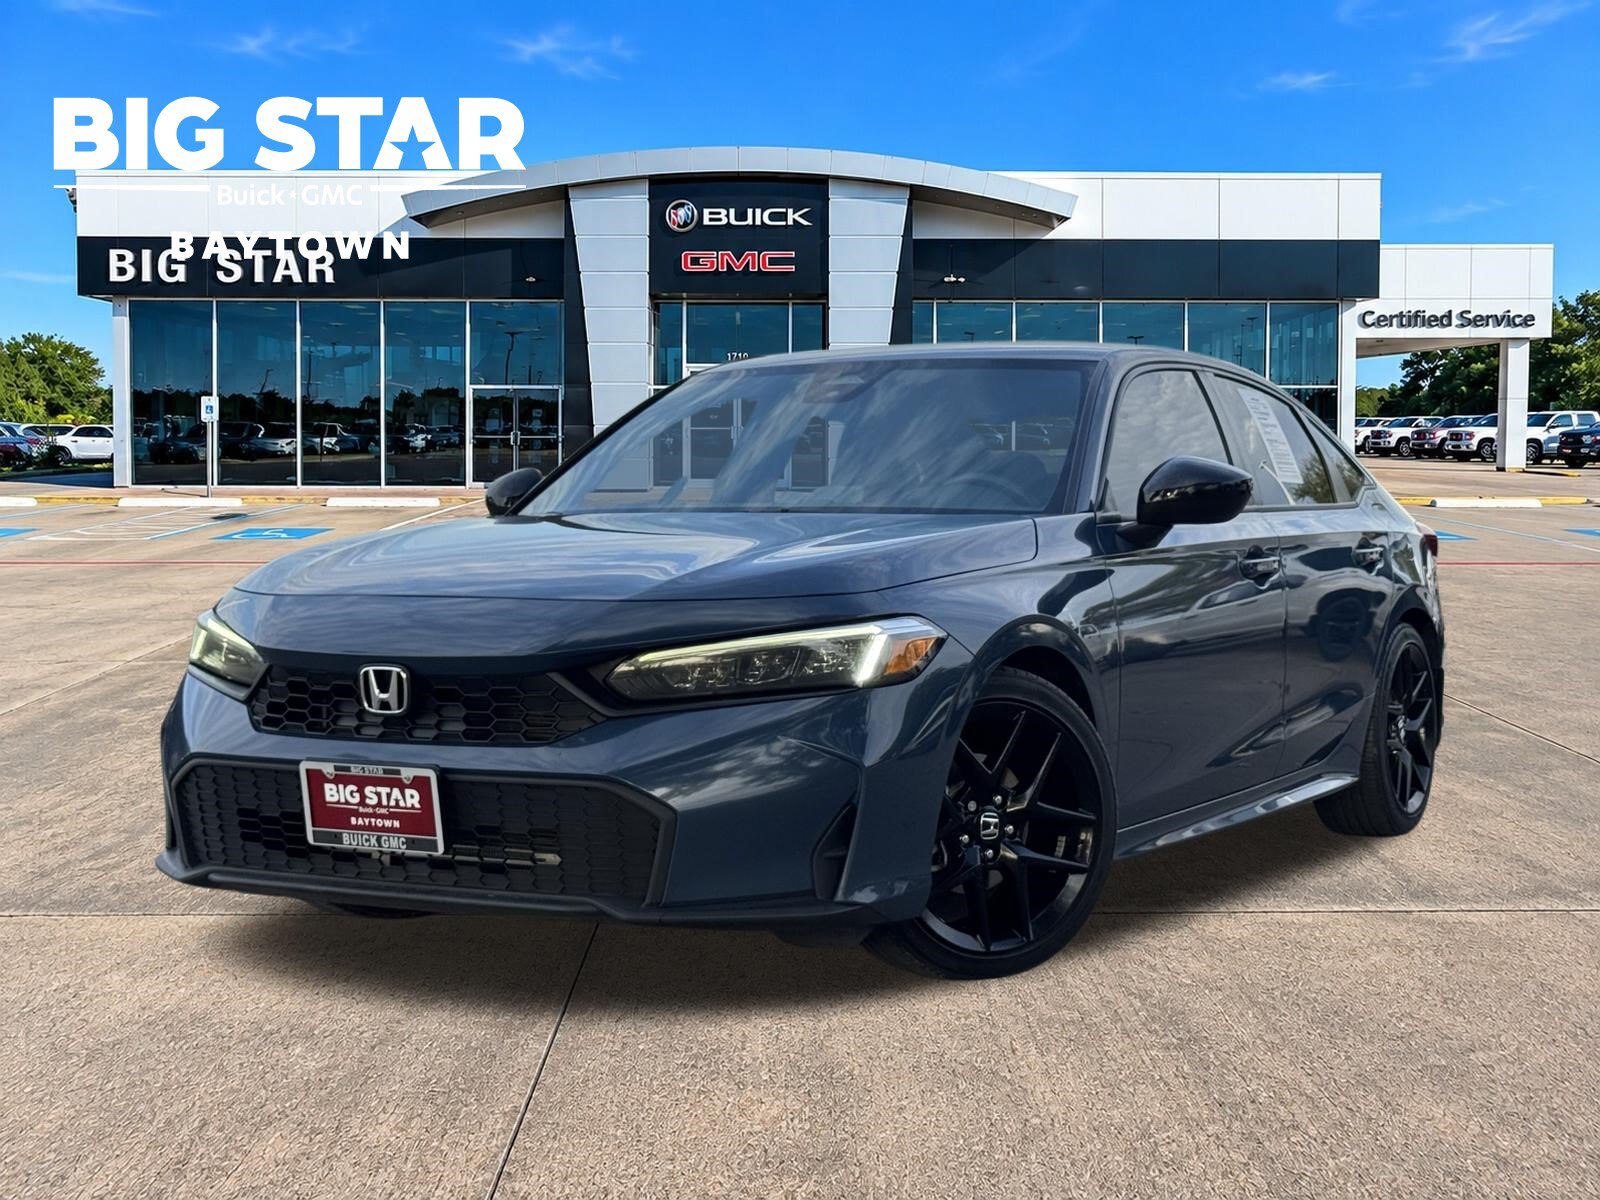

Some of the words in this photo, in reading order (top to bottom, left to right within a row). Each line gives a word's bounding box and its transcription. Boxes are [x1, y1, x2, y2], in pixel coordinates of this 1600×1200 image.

[703, 207, 813, 226] BUICK
[109, 248, 187, 283] BIG
[216, 249, 336, 284] STAR
[681, 251, 796, 272] GMC
[1359, 309, 1452, 328] Certified
[1456, 309, 1536, 328] Service
[323, 783, 361, 804] BIG
[364, 786, 421, 808] STAR
[350, 816, 400, 828] BAYTOWN
[342, 833, 379, 847] BUICK
[381, 837, 407, 849] GMC
